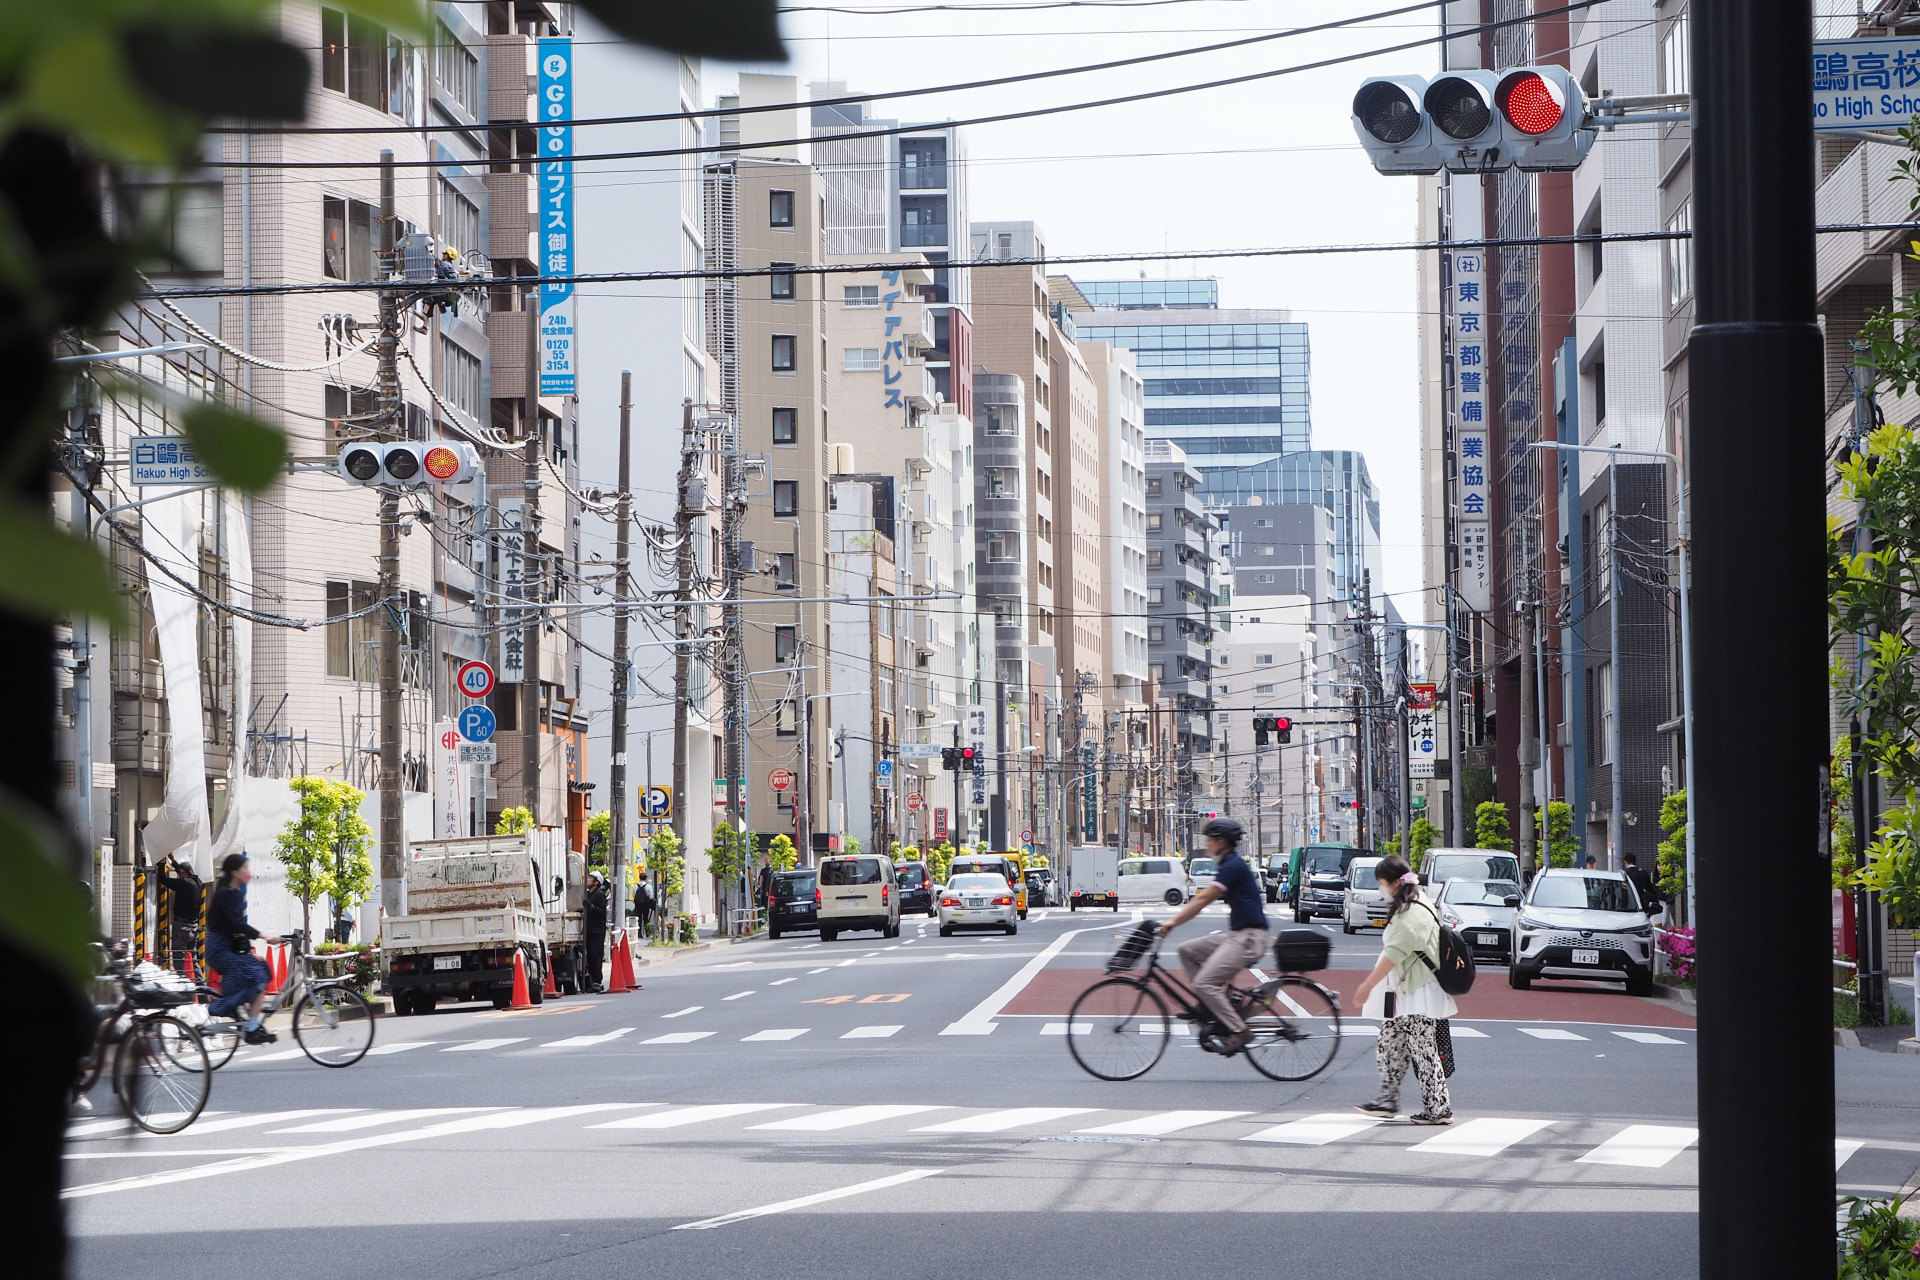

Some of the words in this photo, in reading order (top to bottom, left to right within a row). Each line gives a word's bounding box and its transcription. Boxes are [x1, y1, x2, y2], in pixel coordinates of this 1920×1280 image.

[1835, 96, 1873, 120] High
[548, 315, 567, 326] 24h
[541, 327, 574, 335] 完全個室
[546, 339, 569, 350] 0120
[552, 350, 565, 360] 55
[546, 360, 569, 371] 3154
[136, 467, 166, 479] Hakuo
[169, 466, 190, 480] High
[1464, 535, 1473, 569] 事務局
[1475, 535, 1485, 588] 研修センター
[466, 671, 486, 688] 40
[466, 713, 481, 737] P
[476, 726, 487, 737] 60
[1409, 714, 1420, 751] カレー
[1421, 714, 1433, 739] 牛丼
[1415, 779, 1424, 791] 店
[643, 789, 665, 814] P
[800, 993, 913, 1005] 40
